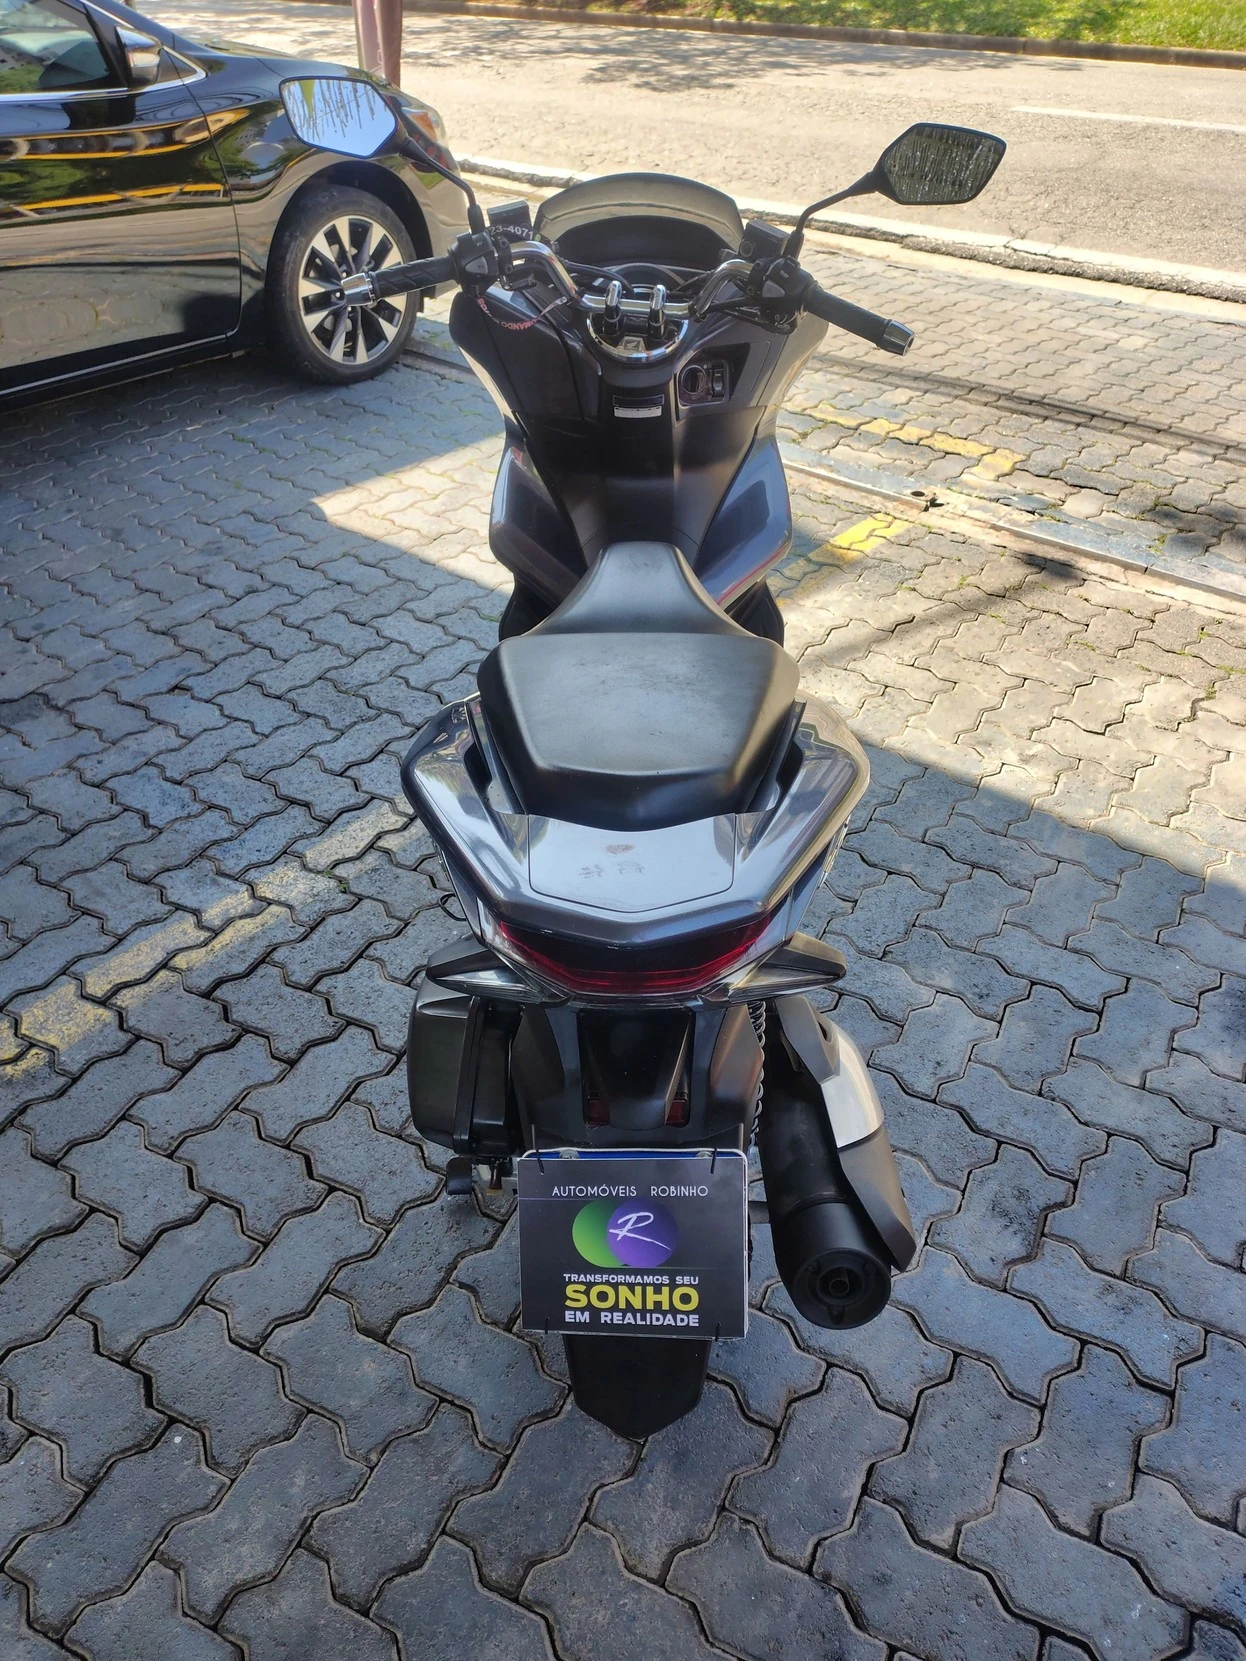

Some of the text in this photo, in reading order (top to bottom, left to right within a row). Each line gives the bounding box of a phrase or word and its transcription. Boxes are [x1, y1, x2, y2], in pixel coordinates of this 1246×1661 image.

[551, 1184, 709, 1197] AUTOMÓVEIS ROBINHO
[608, 1211, 673, 1251] R
[563, 1273, 699, 1285] TRANSFORMAMOS SEU
[564, 1283, 700, 1312] SONHO
[564, 1310, 700, 1327] EM REALIDADE
